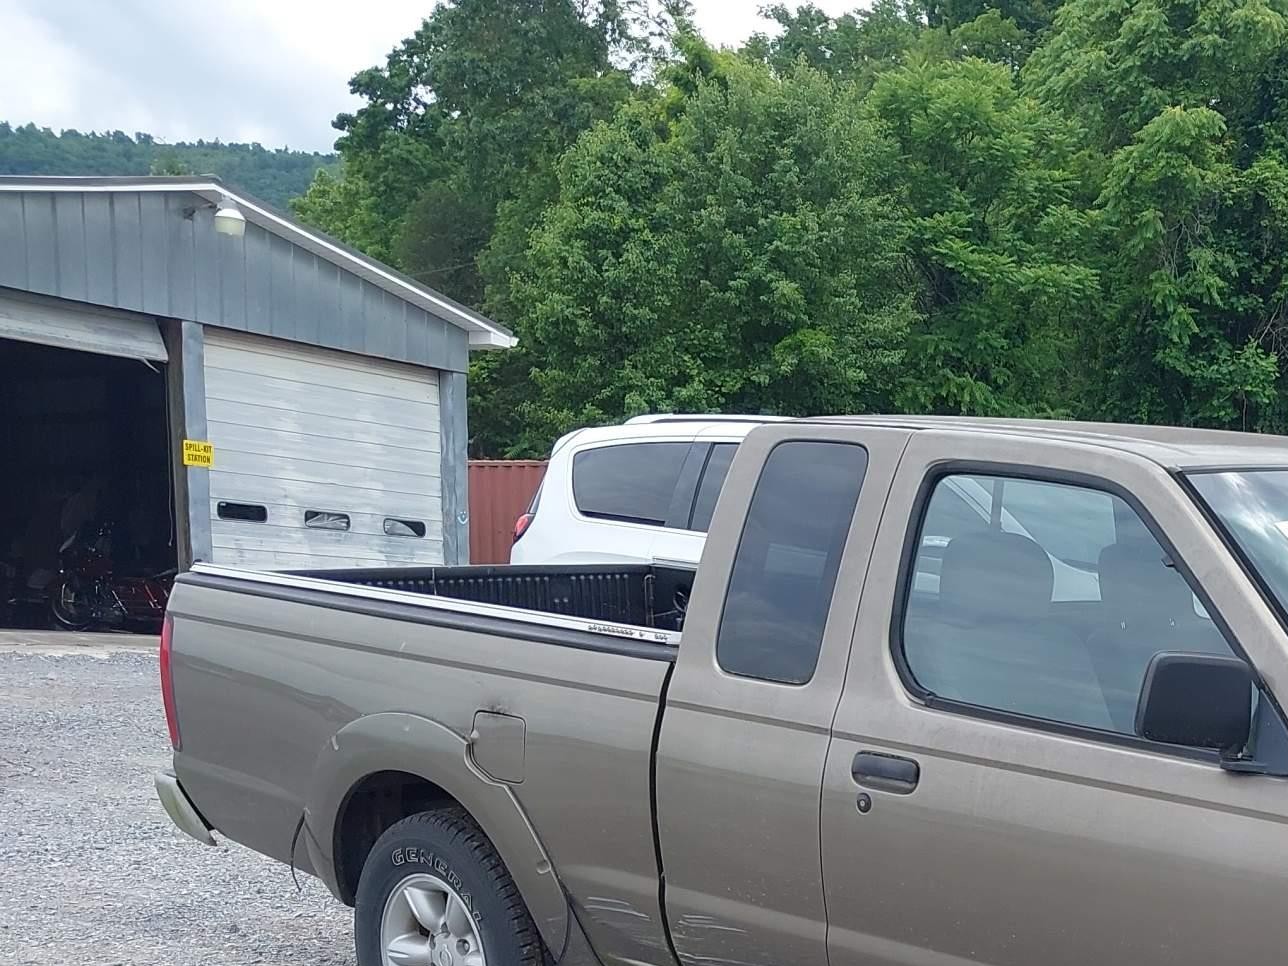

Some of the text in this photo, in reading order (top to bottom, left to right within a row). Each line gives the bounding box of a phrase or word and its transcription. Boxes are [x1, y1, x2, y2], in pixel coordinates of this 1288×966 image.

[185, 443, 212, 453] SPILL-KIT
[187, 454, 211, 464] STATION
[391, 847, 484, 931] GENERAL
